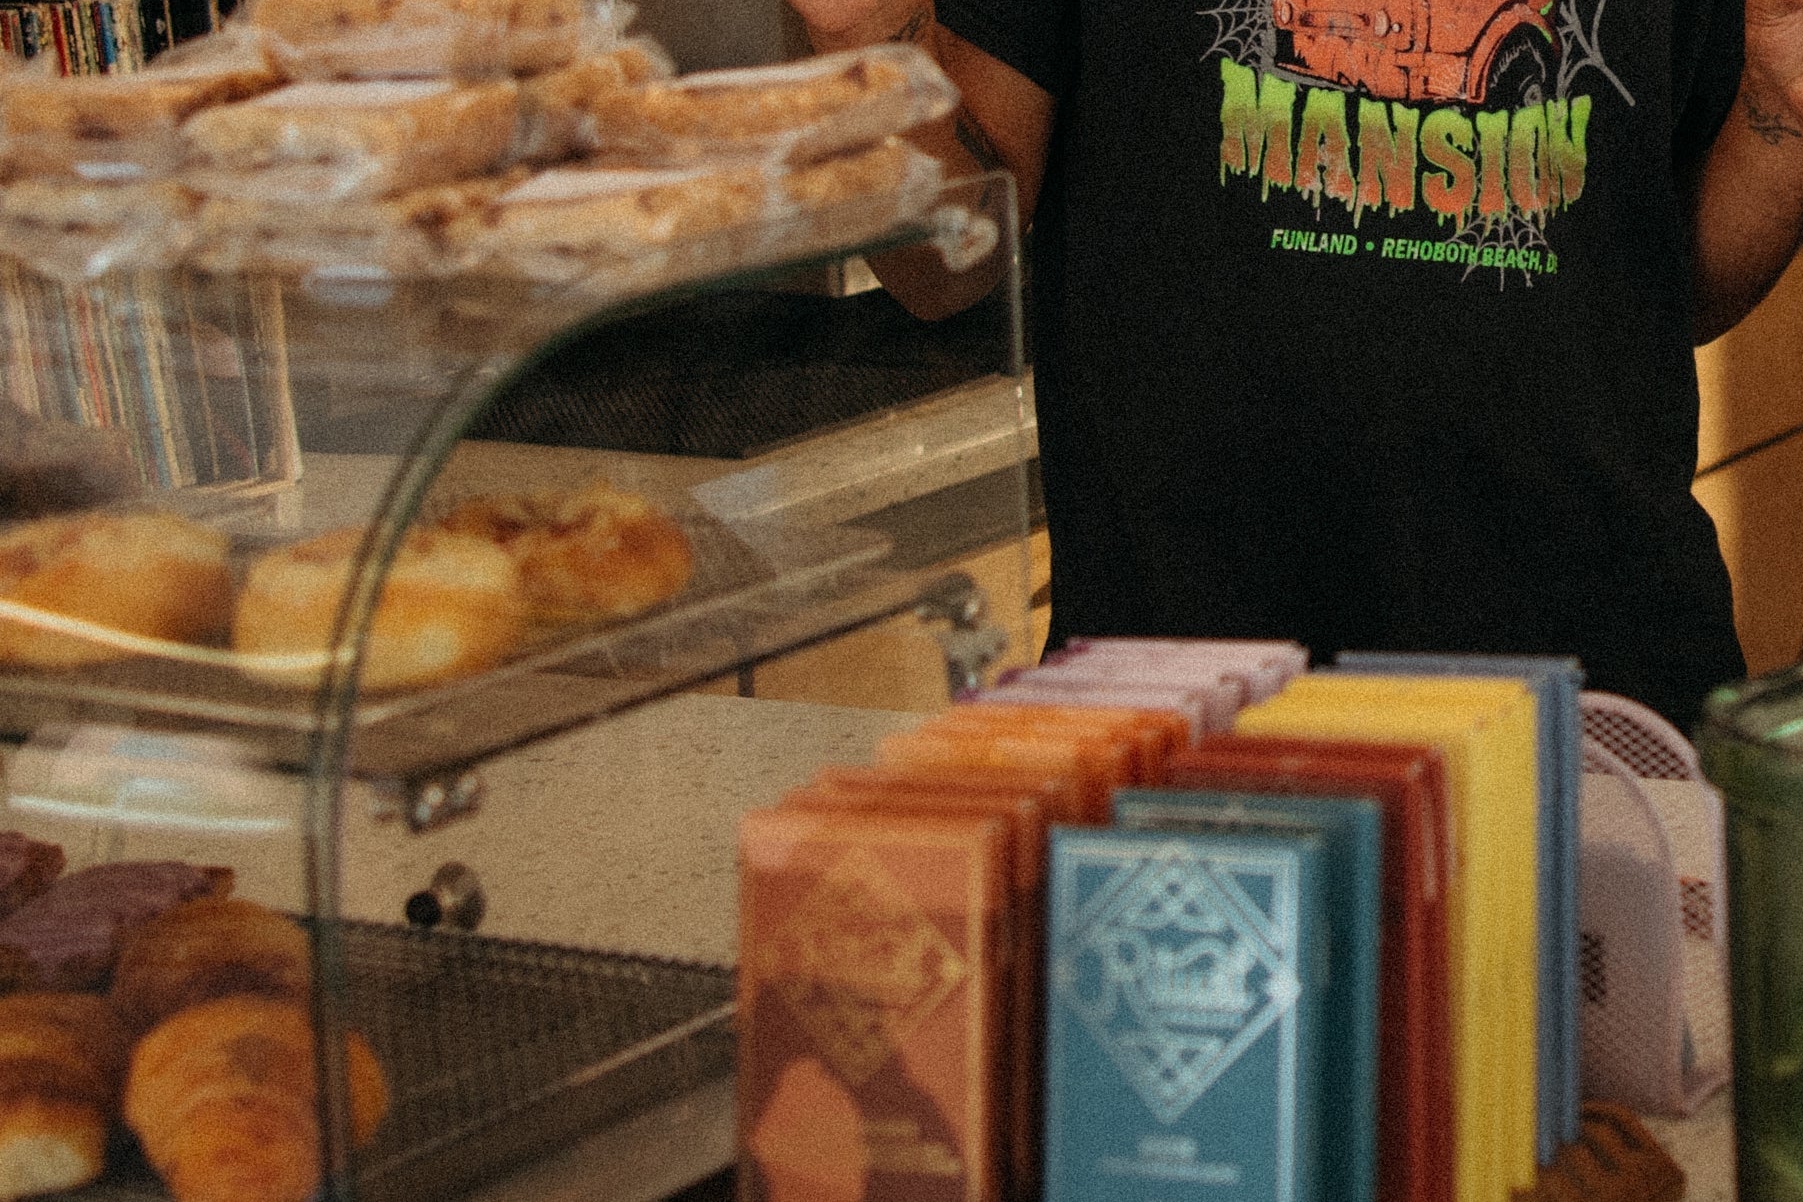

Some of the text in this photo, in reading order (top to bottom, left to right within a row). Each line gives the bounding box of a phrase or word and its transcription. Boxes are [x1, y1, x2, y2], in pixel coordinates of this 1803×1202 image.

[1220, 57, 1592, 236] MANSION
[1271, 228, 1358, 256] FUNLAND
[1381, 237, 1478, 265] REHOBOTH
[1481, 246, 1543, 275] BEACH,
